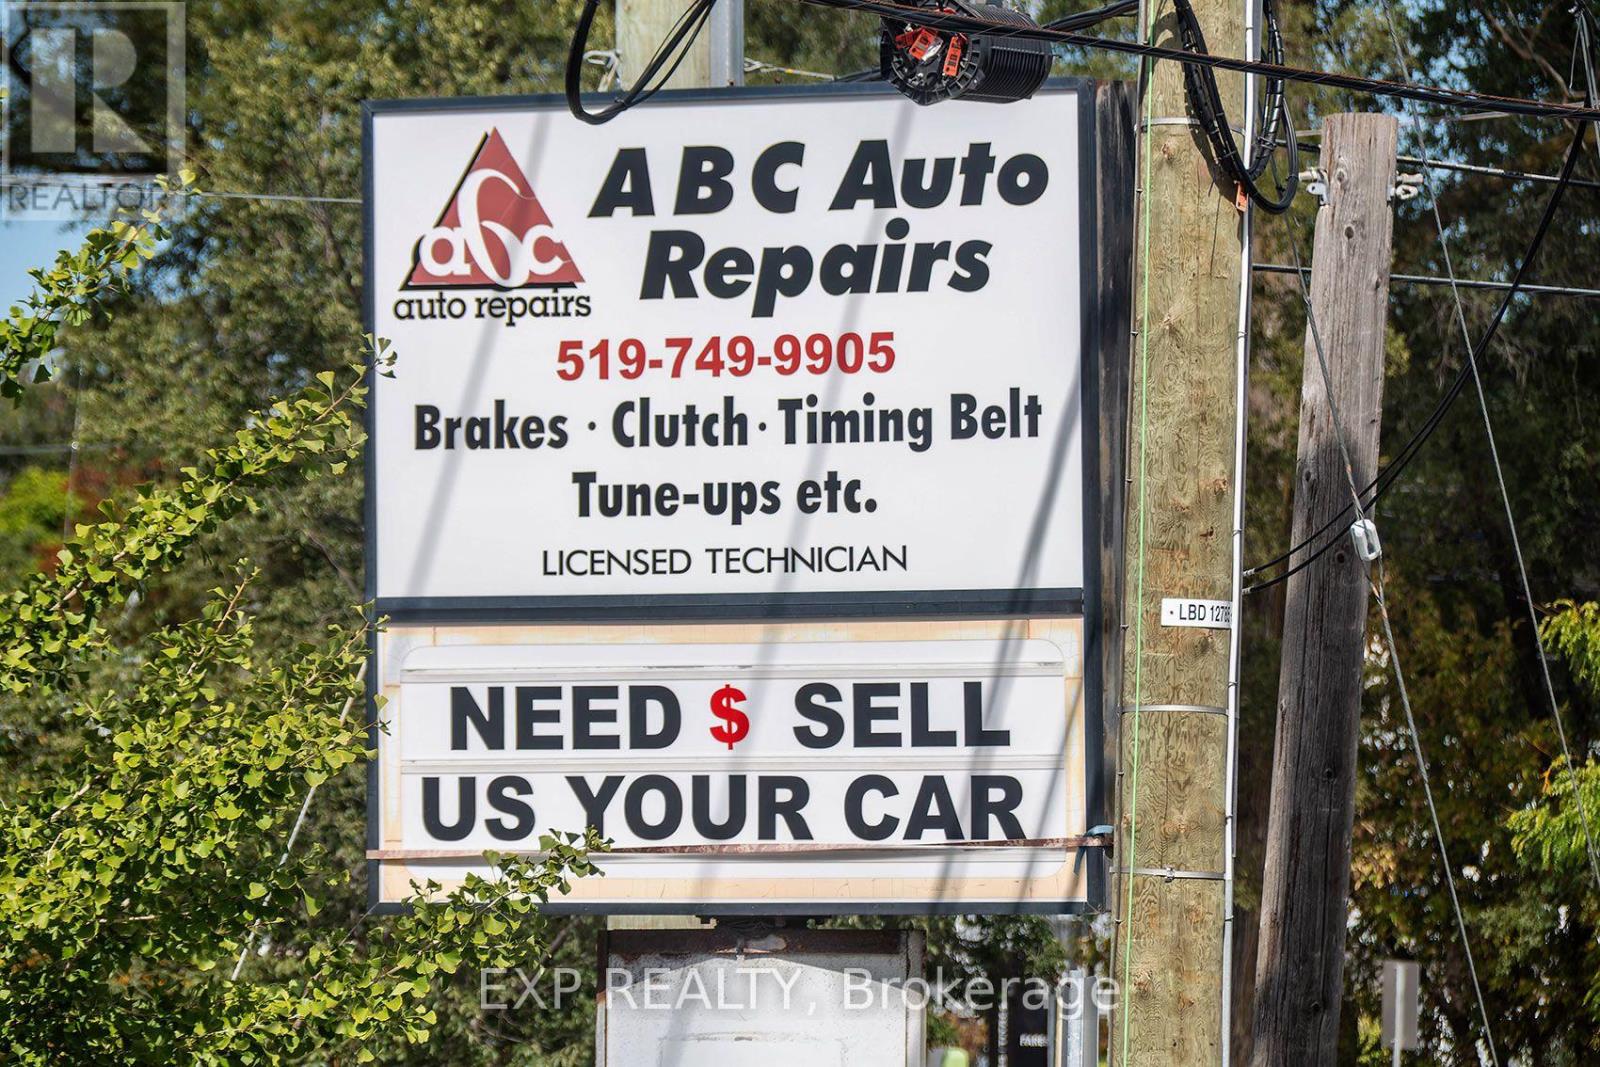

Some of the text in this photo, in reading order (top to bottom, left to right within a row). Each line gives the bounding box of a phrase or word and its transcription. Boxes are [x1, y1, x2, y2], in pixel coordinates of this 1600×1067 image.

[828, 139, 1049, 211] Auto
[639, 217, 993, 318] Repairs
[393, 286, 592, 327] auto repairs
[558, 331, 895, 381] 519-749-9905
[415, 387, 1042, 453] Brakes Clutch Timing Belt
[572, 470, 877, 526] Tune-ups etc.
[543, 545, 907, 576] LICENSED TECHNICIAN
[1178, 603, 1207, 621] LBD
[450, 685, 682, 751] NEED
[793, 681, 1011, 749] SELL
[422, 773, 1027, 842] US YOUR CAR
